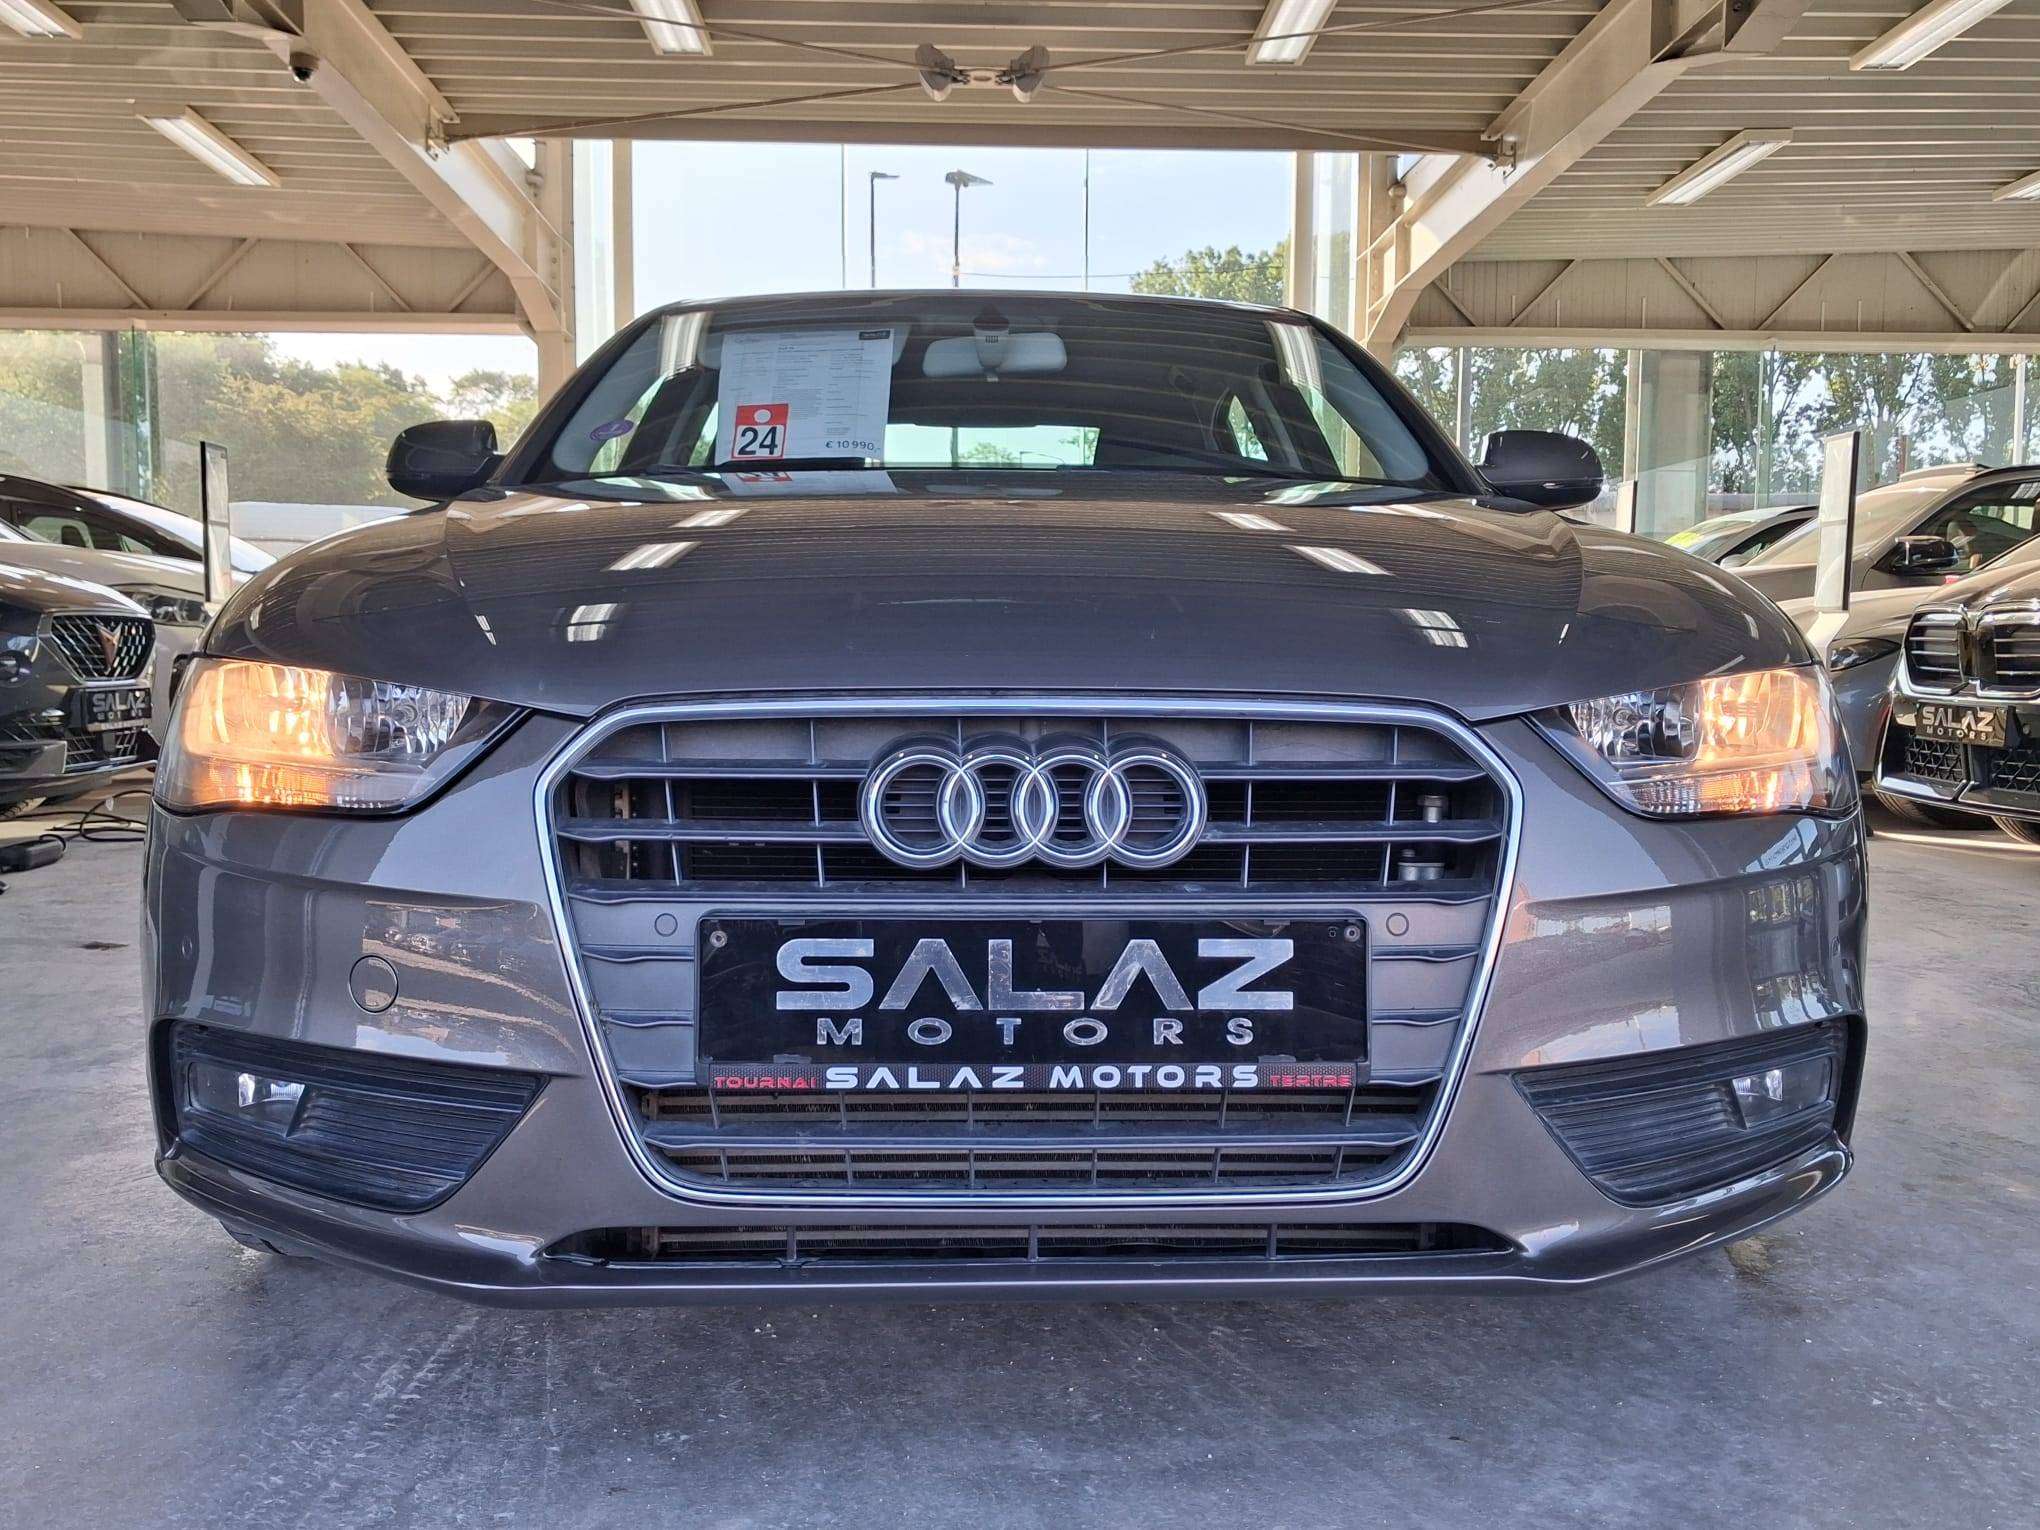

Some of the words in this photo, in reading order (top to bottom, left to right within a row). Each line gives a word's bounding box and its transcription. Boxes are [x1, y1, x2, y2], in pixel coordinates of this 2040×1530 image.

[737, 426, 778, 456] 24
[92, 690, 146, 712] SALAZ
[1922, 706, 1994, 732] SALAZ
[1926, 726, 1987, 740] MOTORS
[775, 938, 1294, 1010] SALAZ
[816, 1018, 1255, 1045] MOTORS
[714, 1076, 817, 1089] TOURNAI
[825, 1066, 1025, 1089] SALAZ
[1050, 1065, 1259, 1089] MOTORS
[1270, 1075, 1352, 1088] TERTRE
